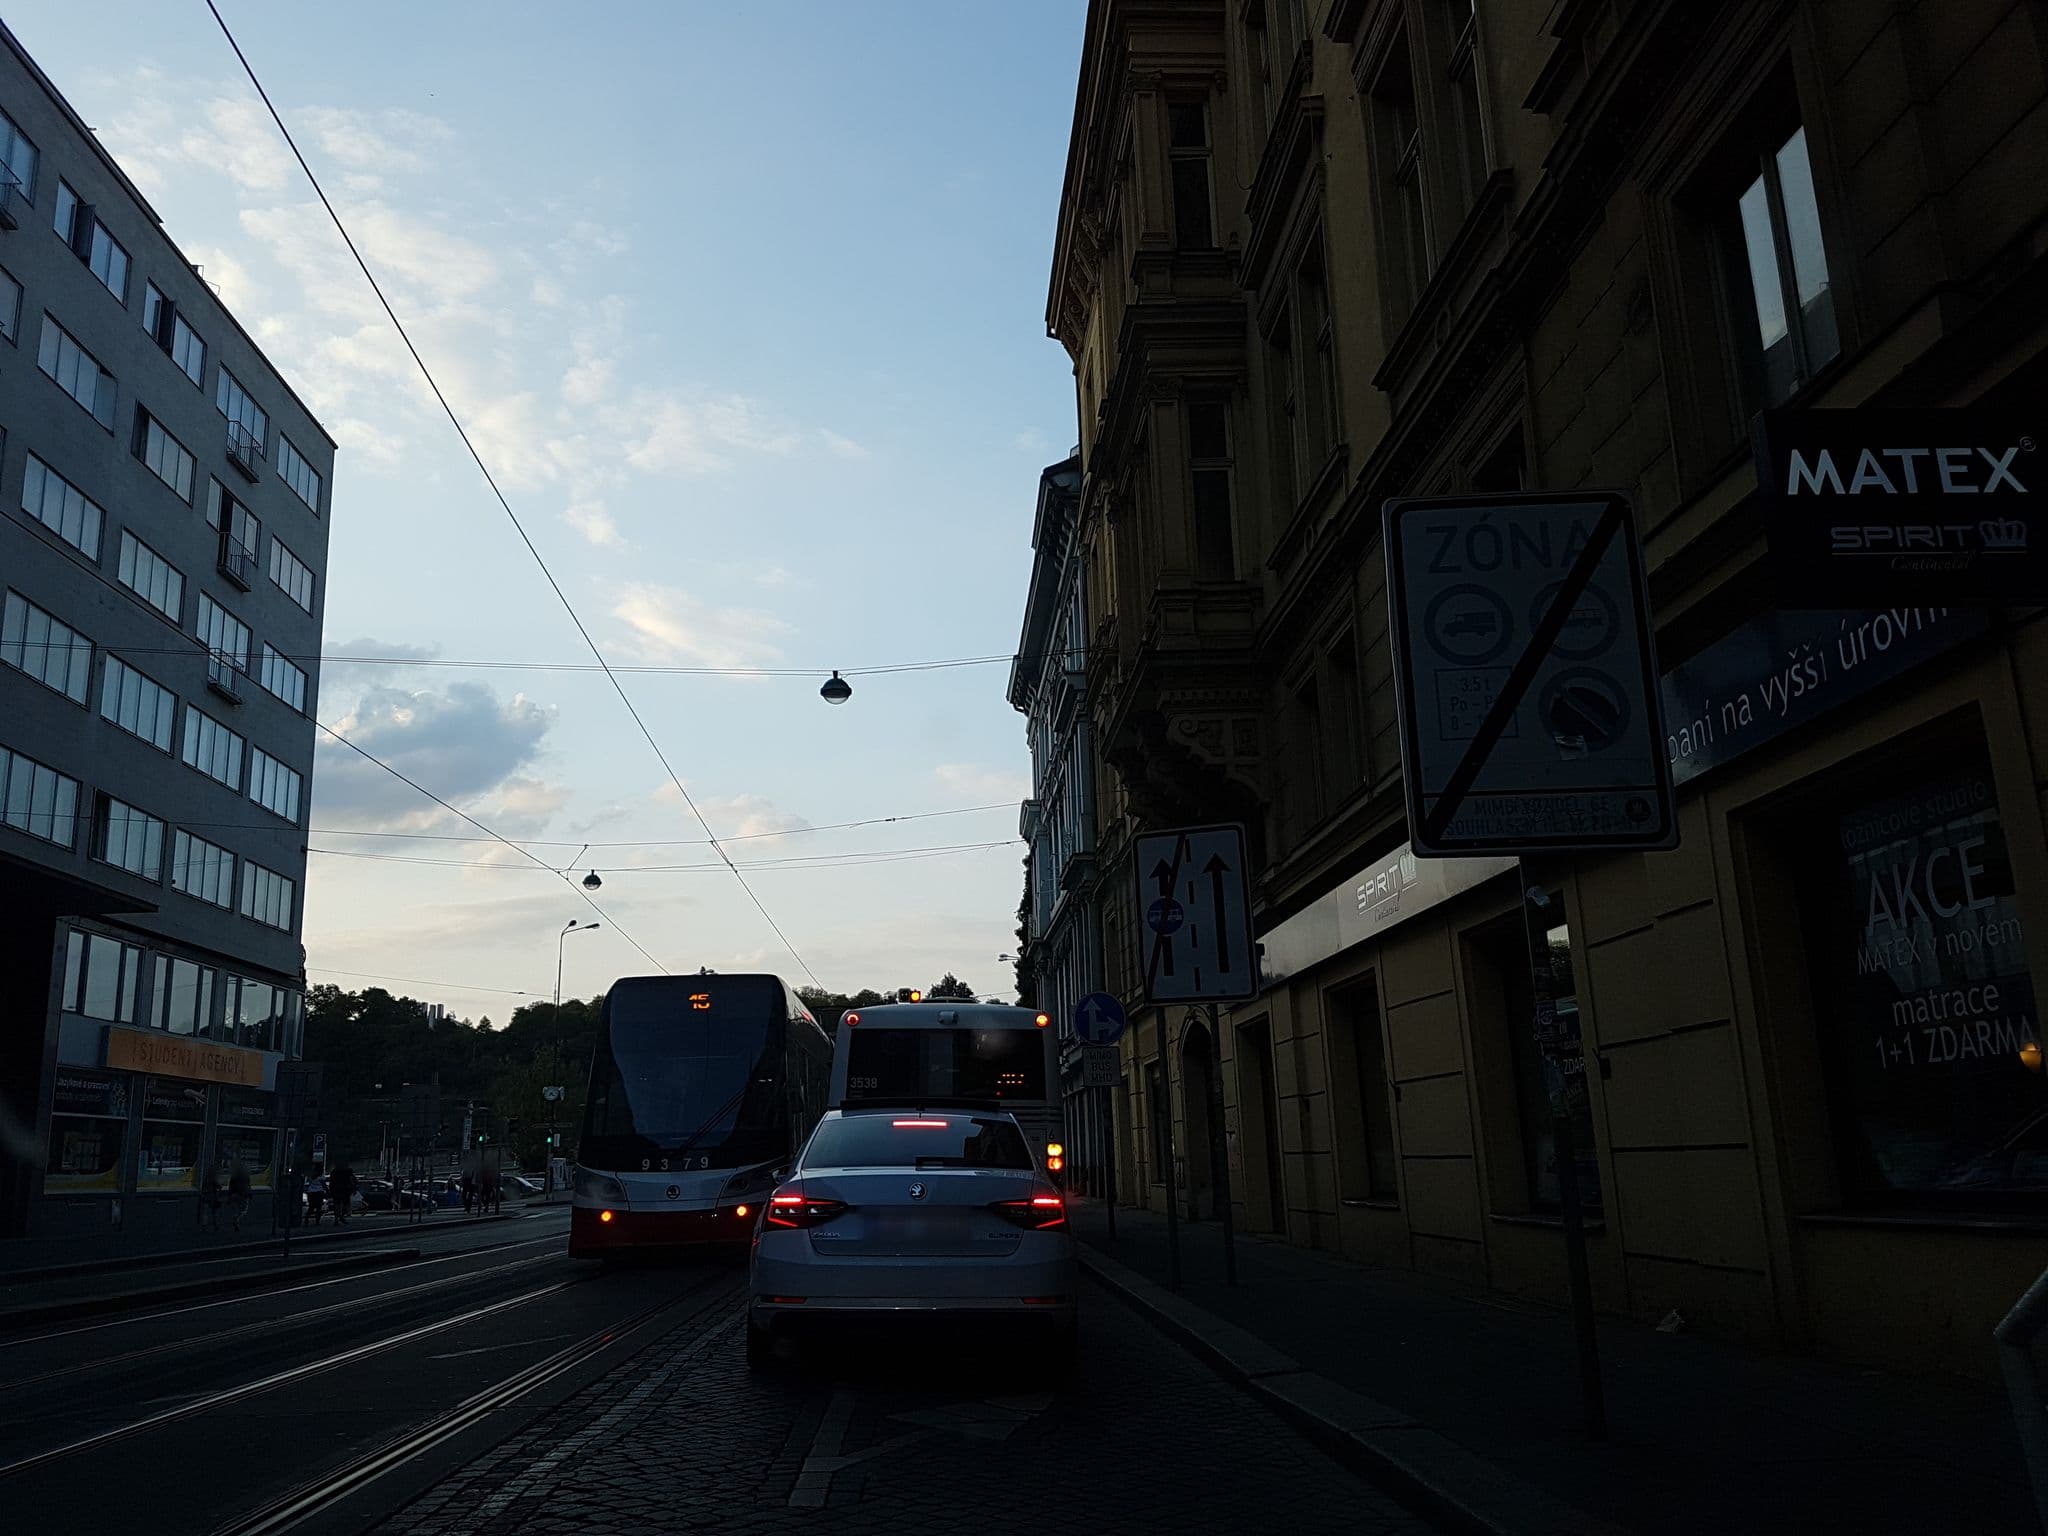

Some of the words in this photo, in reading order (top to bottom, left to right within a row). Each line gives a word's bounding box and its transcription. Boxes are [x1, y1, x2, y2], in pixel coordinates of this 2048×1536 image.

[1787, 447, 2030, 496] MATEX
[1425, 511, 1594, 574] ZÓNA
[1830, 525, 1974, 549] SPIRIT
[1721, 694, 1753, 735] na
[1759, 634, 1827, 717] vyšší
[1356, 863, 1399, 910] SPIRIT
[1868, 837, 1996, 937] AKCE
[1857, 932, 1921, 976] MATEX
[688, 993, 711, 1010] 15
[1891, 983, 2000, 1027] matrace
[1874, 1031, 1914, 1070] 1+1
